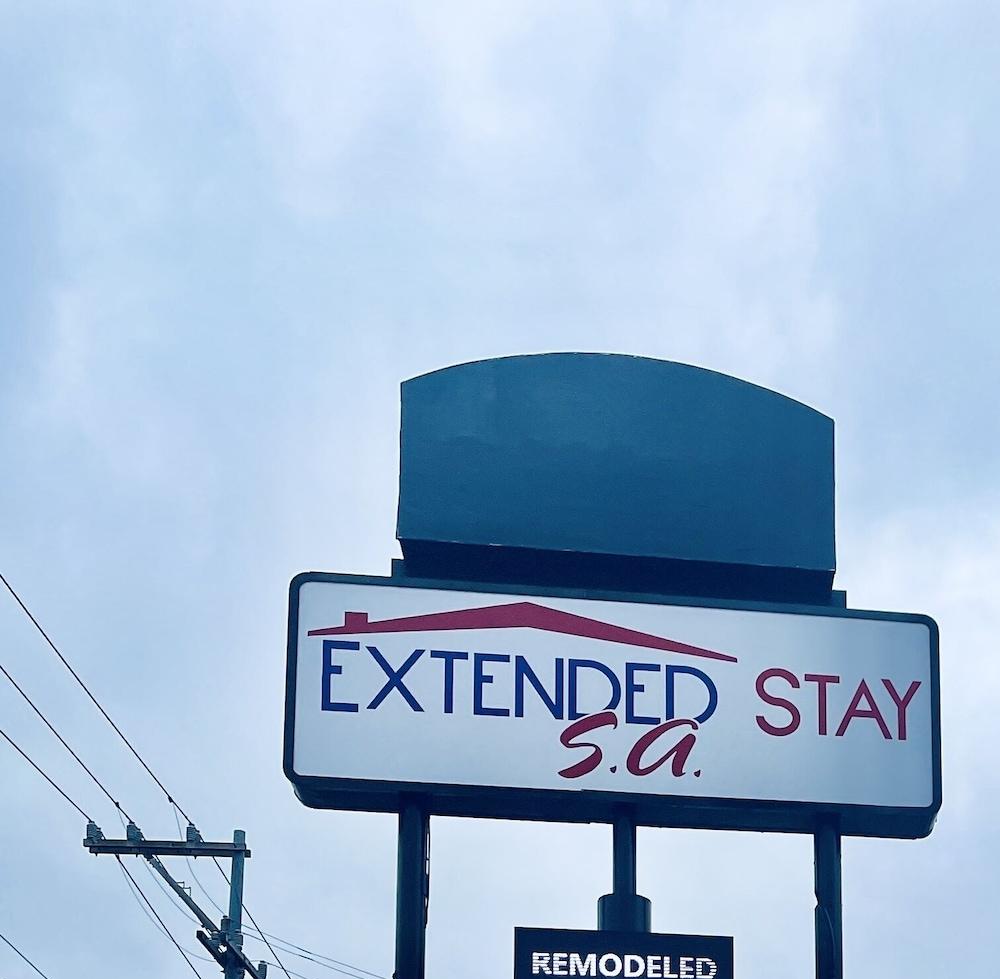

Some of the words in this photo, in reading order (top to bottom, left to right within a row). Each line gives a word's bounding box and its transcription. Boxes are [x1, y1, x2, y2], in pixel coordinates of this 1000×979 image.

[320, 639, 719, 725] EXTENDED
[754, 667, 922, 741] STAY
[532, 951, 718, 979] REMODELED
